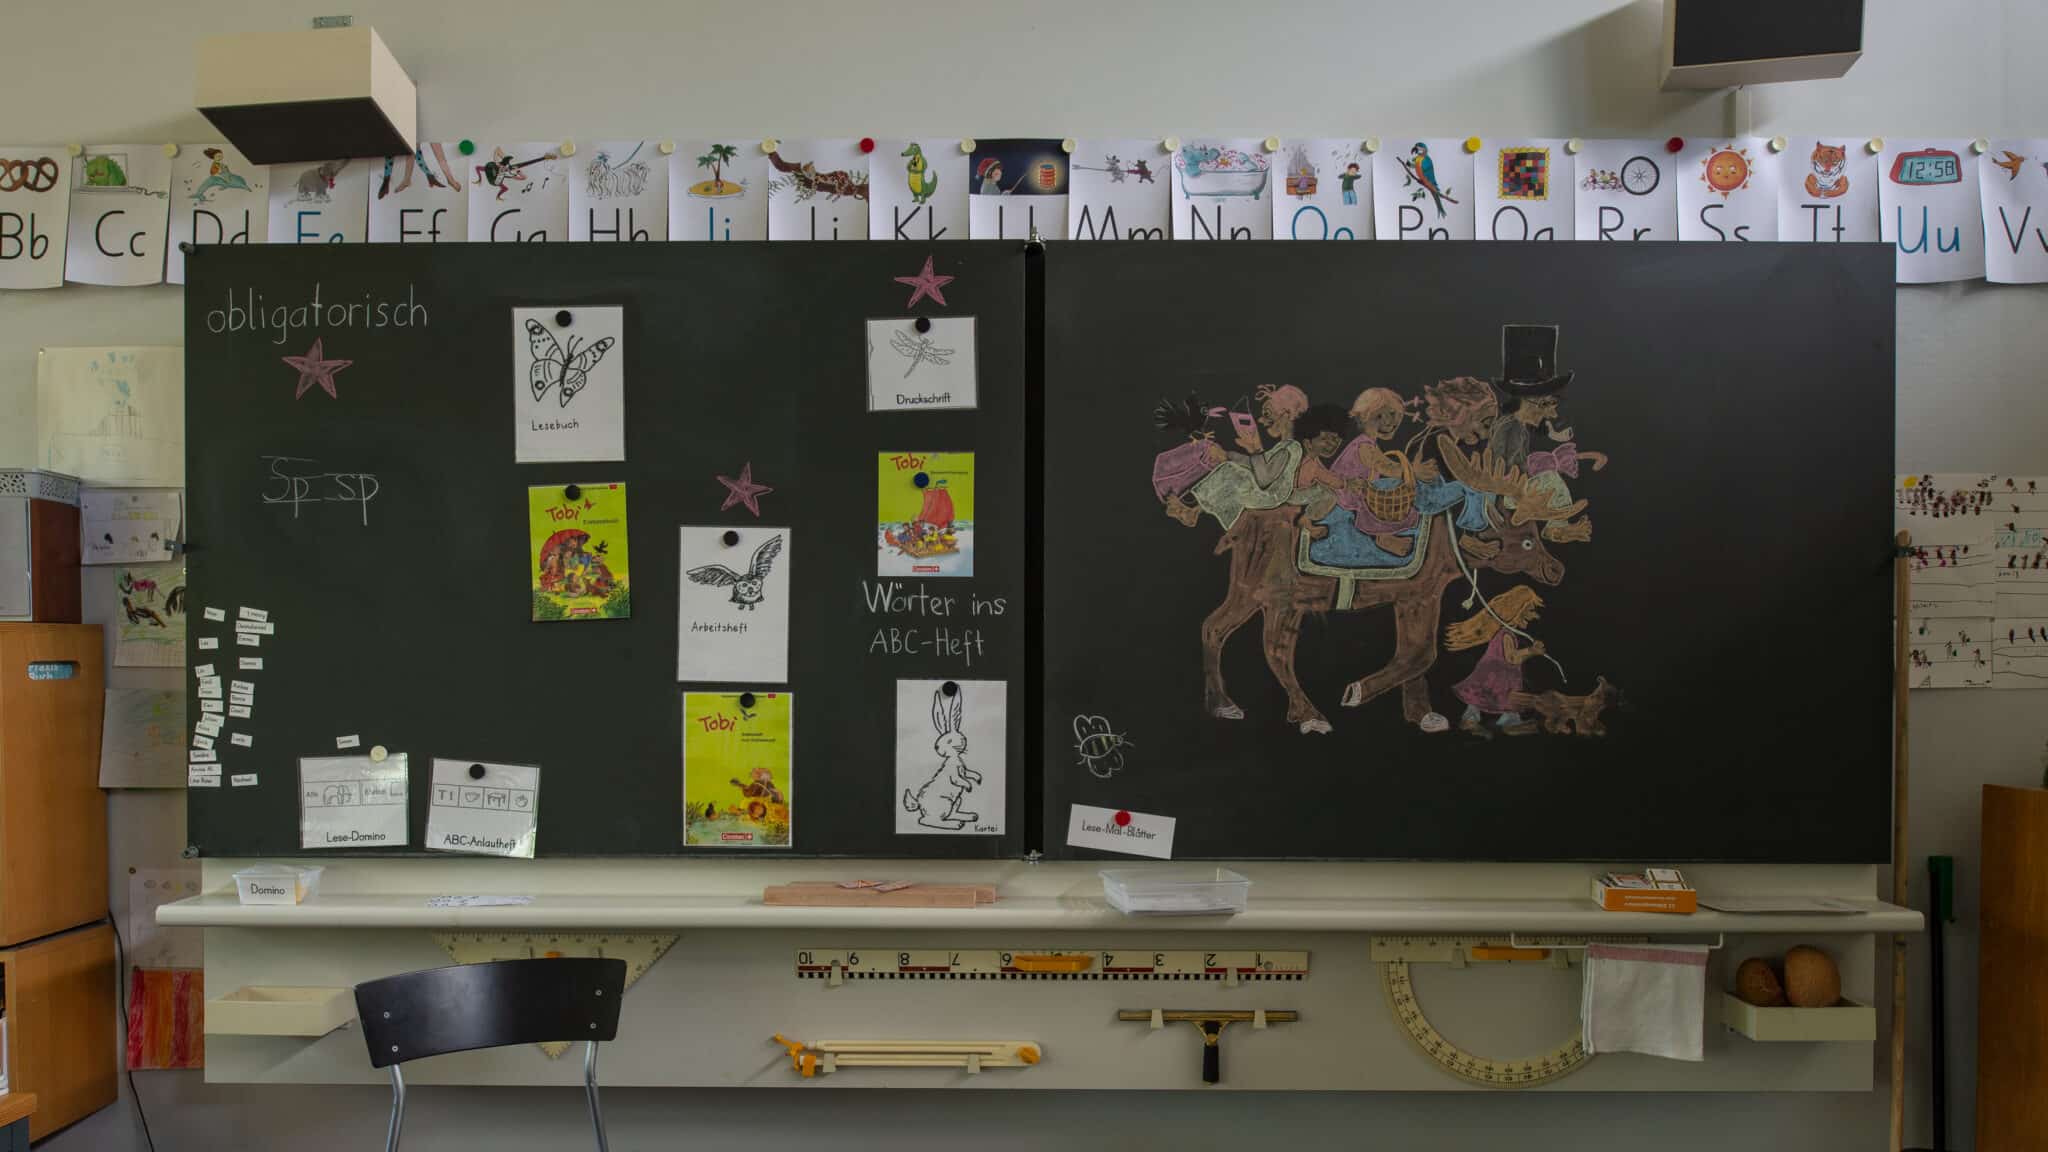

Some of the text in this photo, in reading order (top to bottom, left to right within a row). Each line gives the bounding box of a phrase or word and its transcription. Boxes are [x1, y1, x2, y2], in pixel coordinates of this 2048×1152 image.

[1908, 160, 1955, 179] 12:58
[1800, 204, 1846, 242] Tt
[1897, 205, 1961, 253] Uu
[0, 212, 49, 259] Bb
[95, 210, 146, 256] Cc
[207, 282, 429, 345] obligatorisch
[896, 392, 952, 405] Druckschrift
[531, 419, 580, 431] Lesebuch
[890, 453, 927, 471] Tobi
[545, 503, 582, 522] Tobi
[863, 581, 1008, 616] Wörter ins
[691, 622, 749, 634] Arbeitsheft
[869, 627, 985, 667] ABC-Heft
[697, 712, 738, 733] Tobi
[326, 830, 386, 843] Lese-Domino
[443, 833, 517, 851] ABC-Anlautheft
[250, 883, 286, 896] Domino
